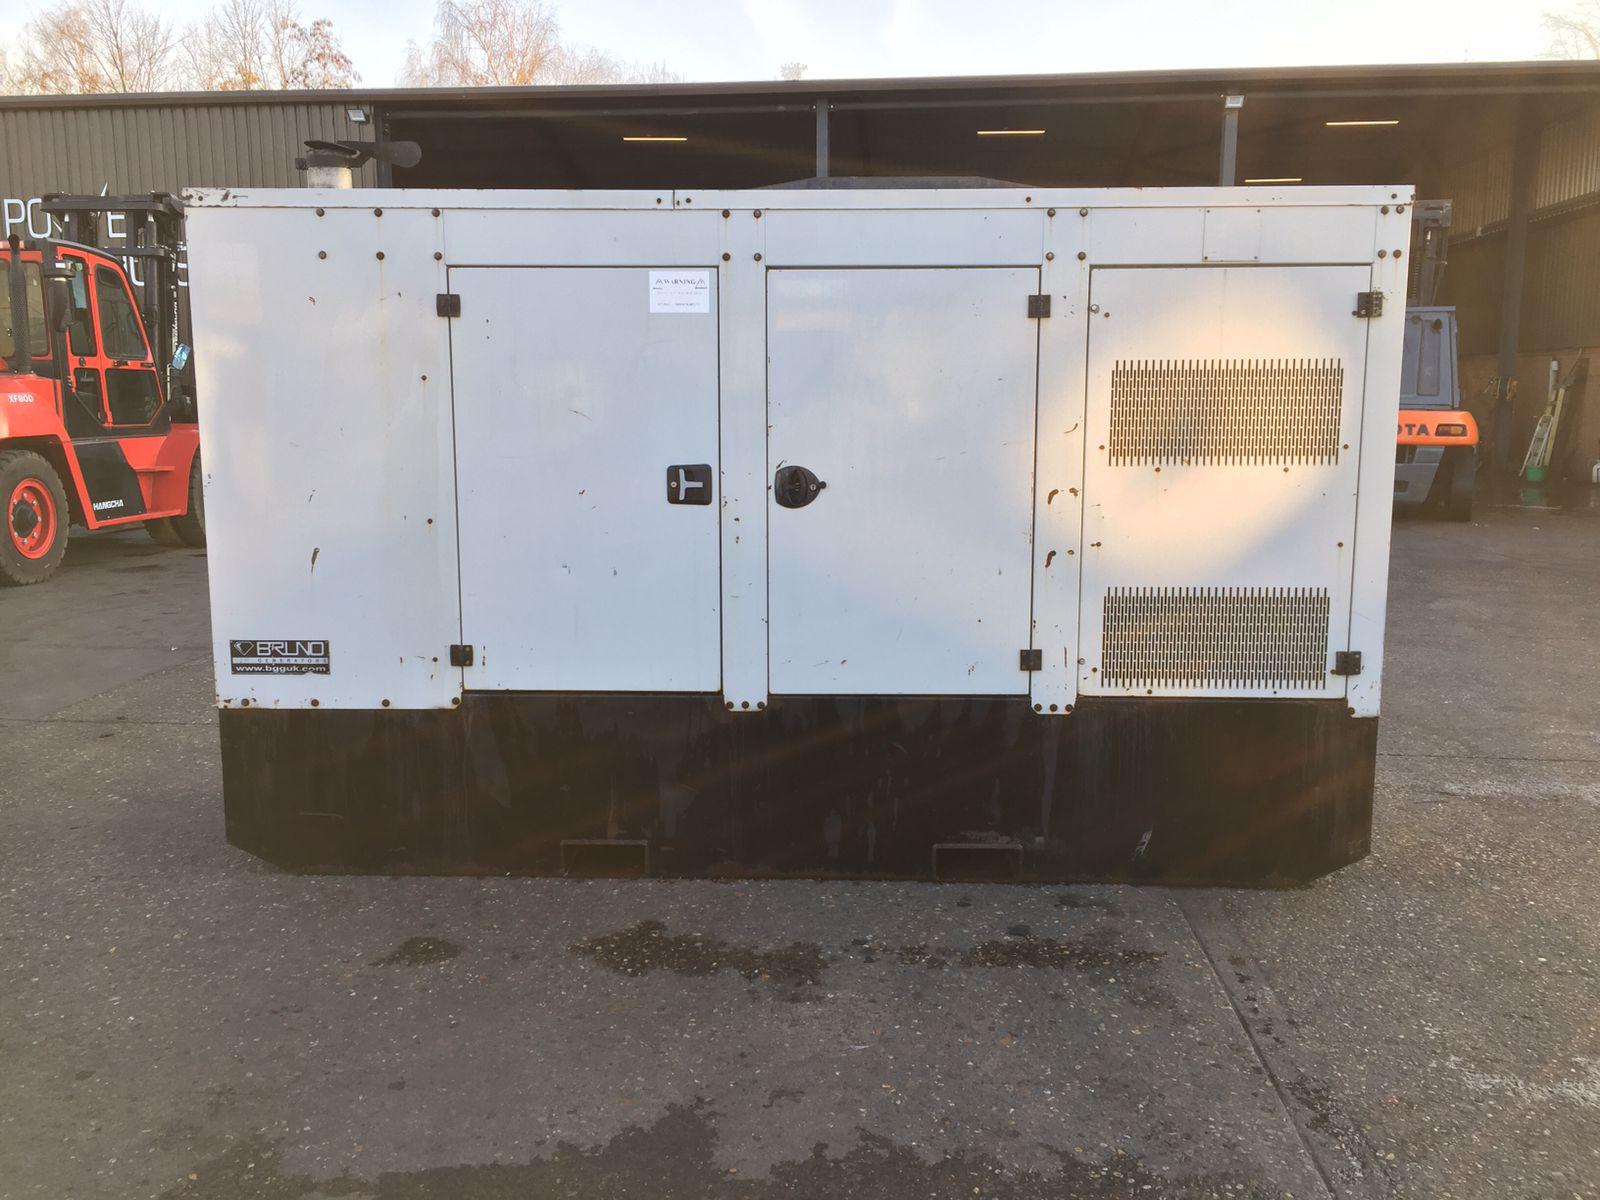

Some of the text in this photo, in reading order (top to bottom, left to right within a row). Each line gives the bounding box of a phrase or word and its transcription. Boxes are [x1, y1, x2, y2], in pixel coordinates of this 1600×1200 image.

[93, 499, 124, 511] HANGCHA
[256, 641, 324, 656] BRUNO
[236, 665, 326, 673] www.bgguk.com
